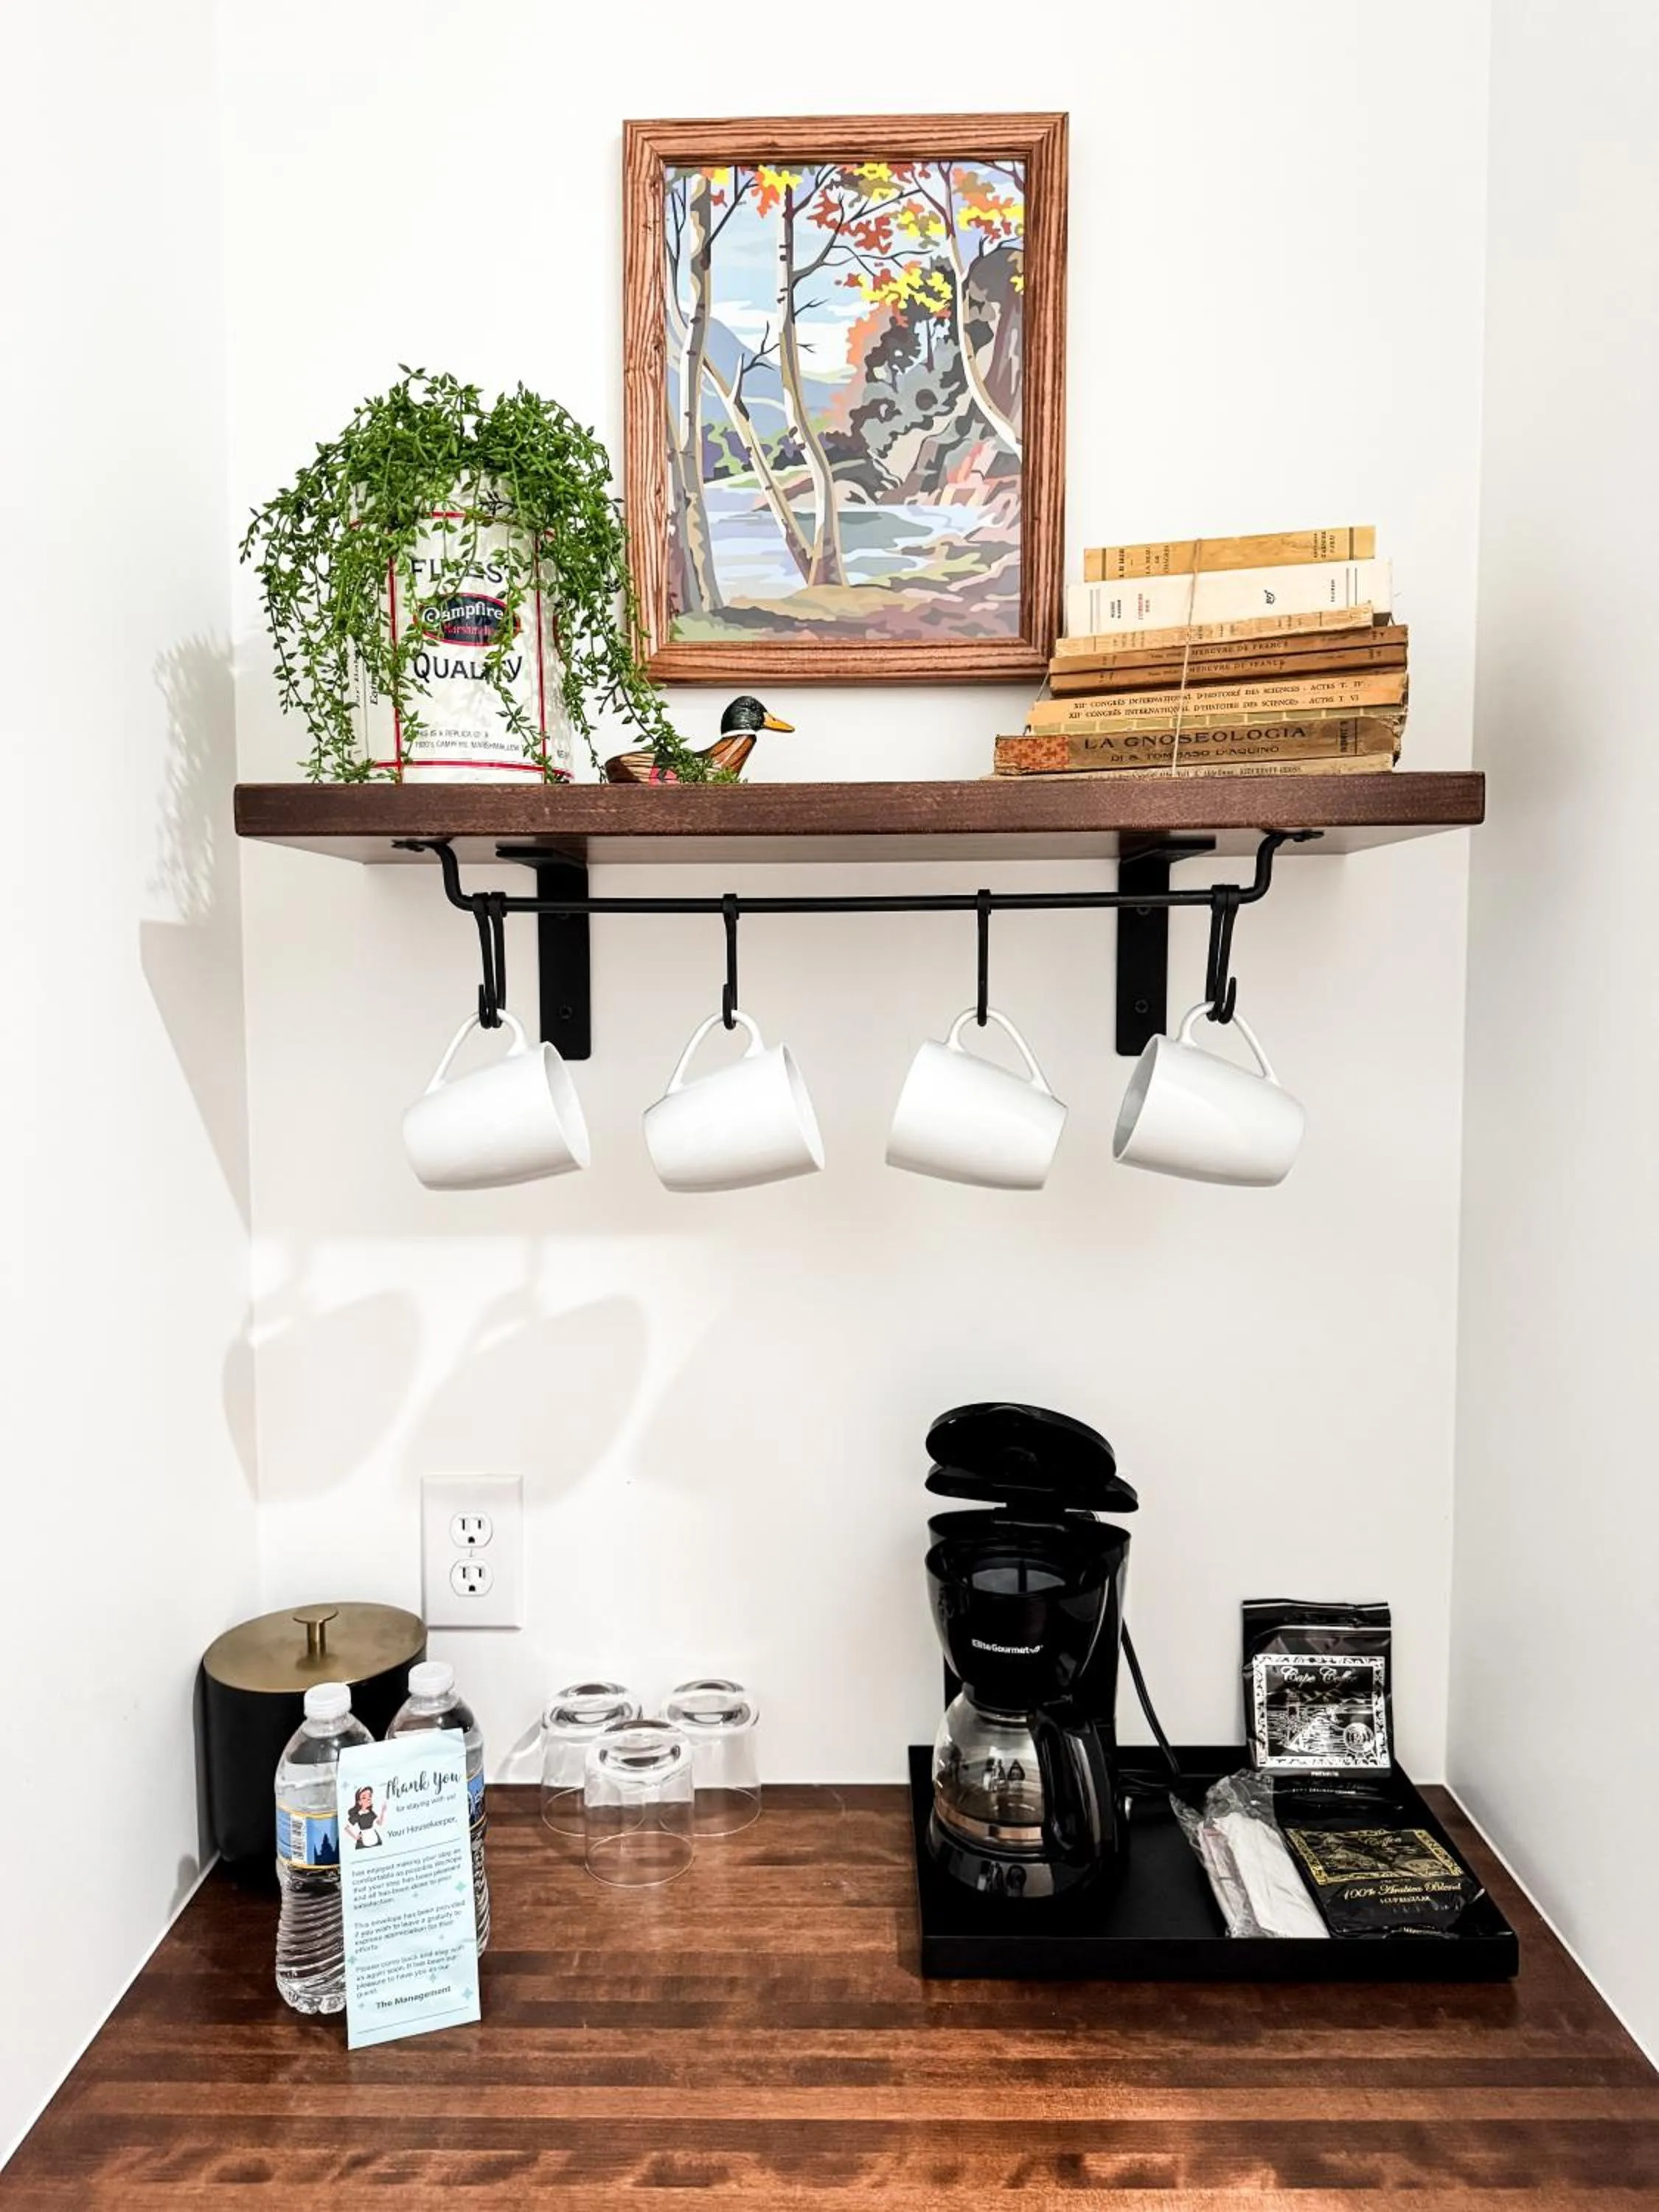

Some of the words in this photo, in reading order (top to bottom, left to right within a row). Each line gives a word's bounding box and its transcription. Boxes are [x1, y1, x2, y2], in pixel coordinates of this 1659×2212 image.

[422, 602, 504, 626] Campfire
[413, 652, 523, 684] QUALY
[1310, 683, 1335, 692] ACTES
[1085, 737, 1114, 751] LA
[1124, 727, 1307, 748] GNOSEOLOGIA
[1216, 745, 1279, 756] D'AQUINO
[1281, 1666, 1316, 1688] Cape
[379, 1770, 430, 1799] Thank
[434, 1770, 461, 1795] You
[407, 1799, 430, 1810] staying
[387, 1829, 406, 1838] Your
[1343, 1889, 1377, 1900] 100%
[1377, 1884, 1423, 1895] Arabica
[375, 1999, 393, 2009] The
[394, 1985, 451, 2006] Management
